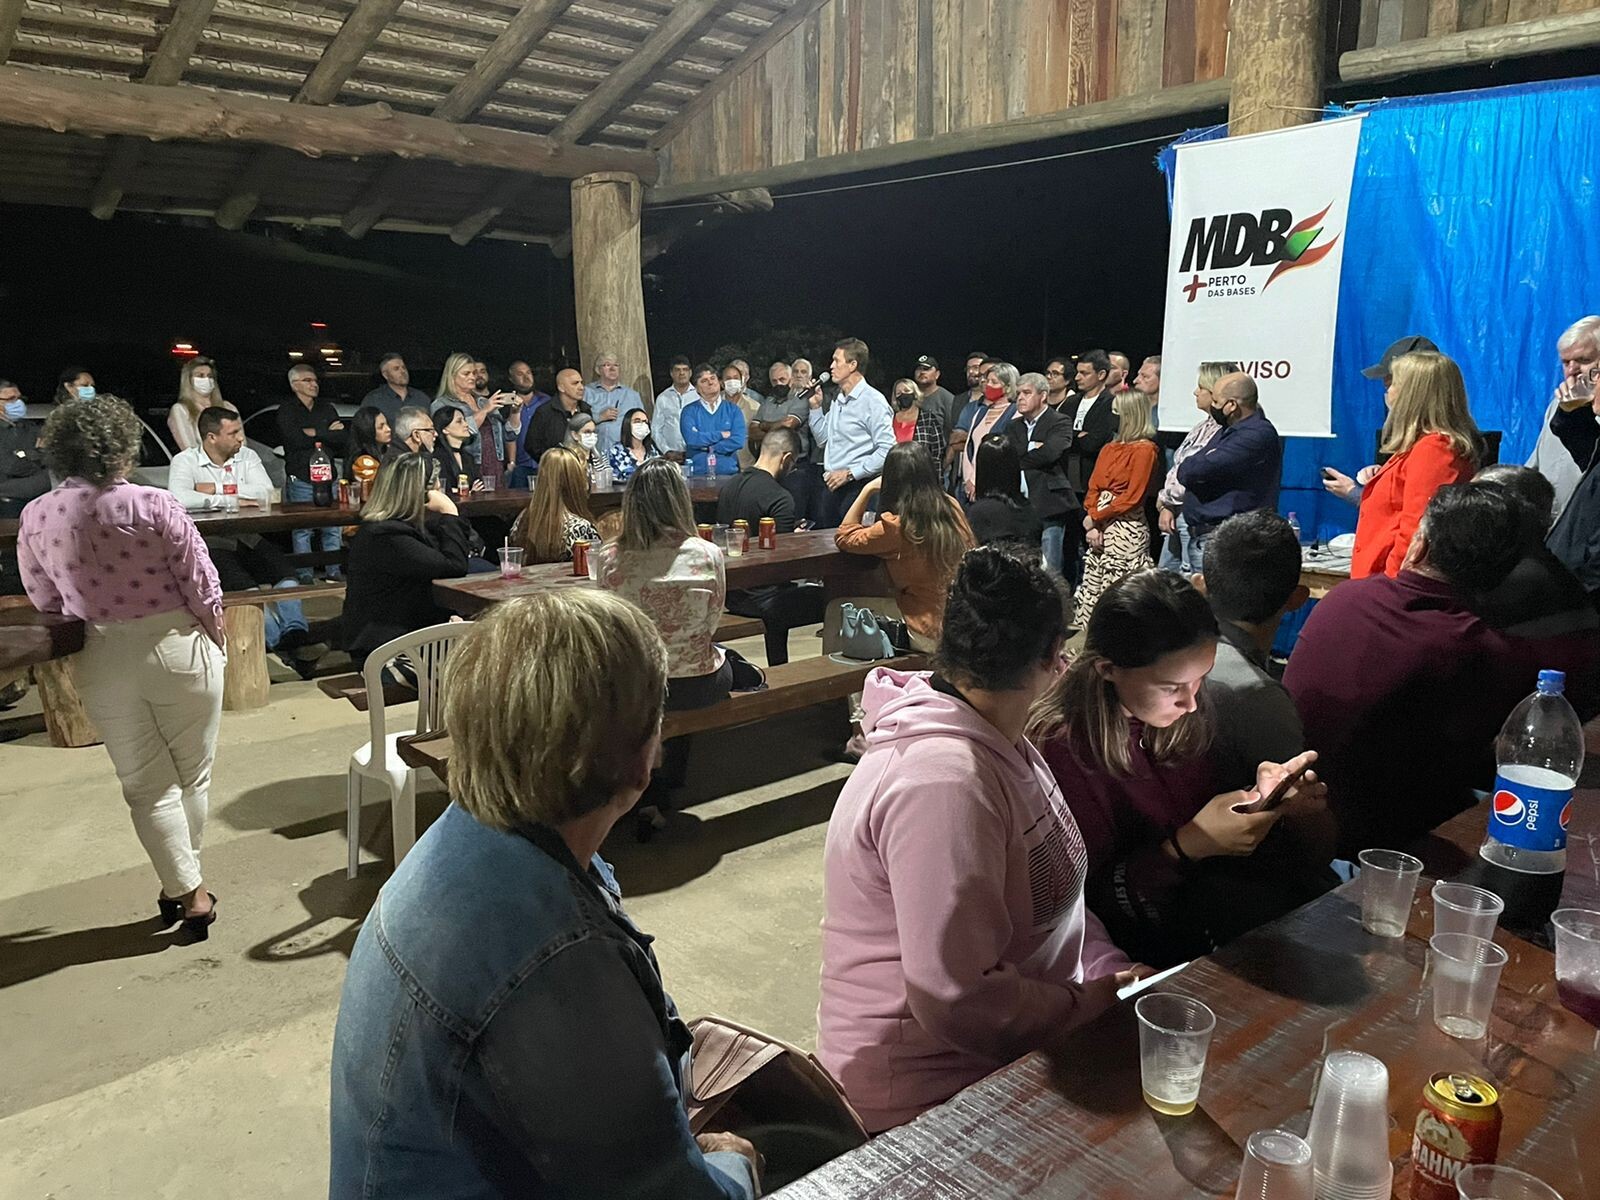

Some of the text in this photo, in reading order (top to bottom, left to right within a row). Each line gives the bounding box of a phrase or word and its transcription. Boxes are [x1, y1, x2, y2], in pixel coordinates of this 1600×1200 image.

[1179, 208, 1292, 272] MDB
[1207, 287, 1256, 297] DAS BASES
[1208, 274, 1247, 287] PERTO
[1526, 799, 1539, 830] pepsi
[1412, 1134, 1472, 1181] RAHM
